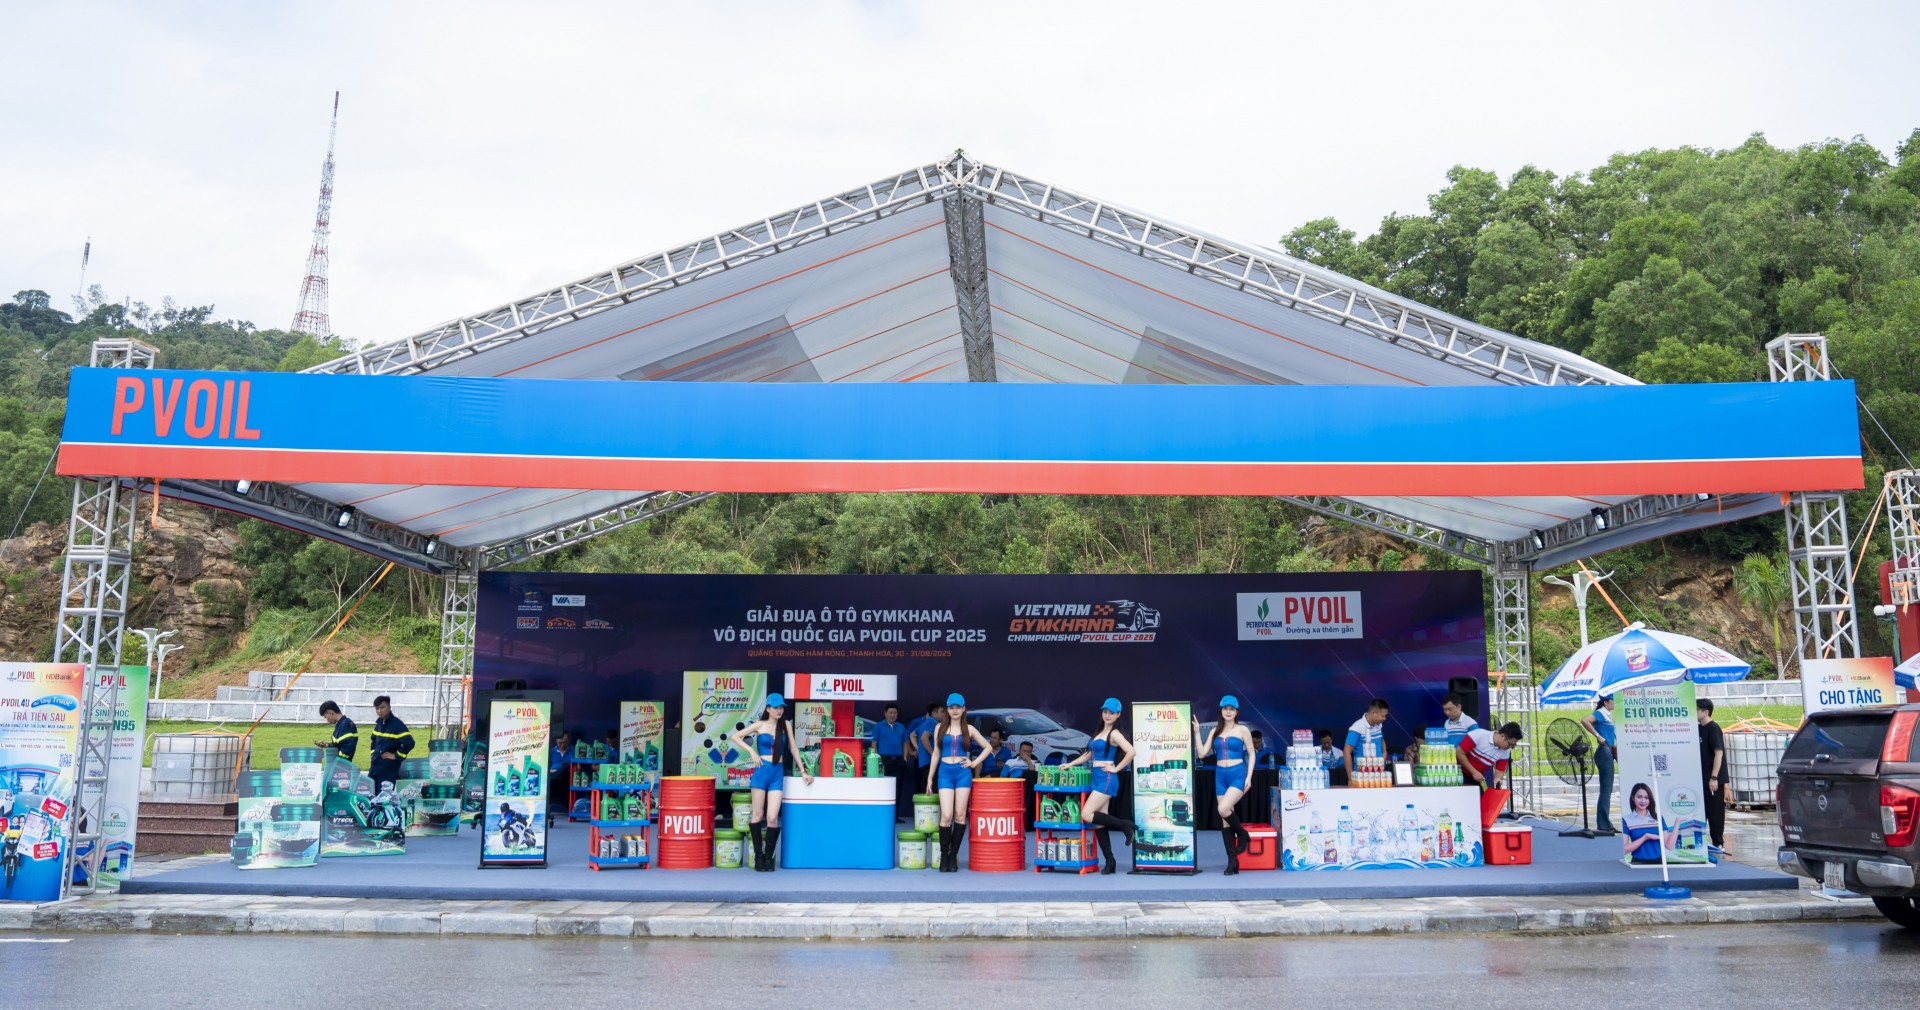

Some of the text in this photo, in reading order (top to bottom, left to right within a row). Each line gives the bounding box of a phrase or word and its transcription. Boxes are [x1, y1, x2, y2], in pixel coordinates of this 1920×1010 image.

[111, 376, 261, 441] PVOIL
[746, 605, 954, 622] GIẢI ĐUA Ô TÔ GYMKHANA
[1014, 604, 1091, 616] VIETNAM
[1284, 596, 1354, 624] PVOIL
[1010, 619, 1115, 632] GYMKHANA
[1342, 624, 1354, 634] gần
[714, 623, 986, 645] VÔ ĐỊCH QUỐC GIA PVOIL CUP 2025
[18, 671, 36, 680] PVOIL
[100, 675, 126, 686] PVIL
[714, 678, 744, 690] PVOIL
[834, 678, 864, 692] PVOIL
[1820, 687, 1882, 707] CHO TẶNG
[50, 712, 66, 721] SAU
[516, 708, 538, 717] PVOIL
[1156, 710, 1178, 720] PVOIL
[1624, 706, 1688, 718] E10 RON95
[1134, 732, 1150, 742] PV
[664, 816, 704, 834] PVOIL
[977, 817, 1008, 836] PVOIL
